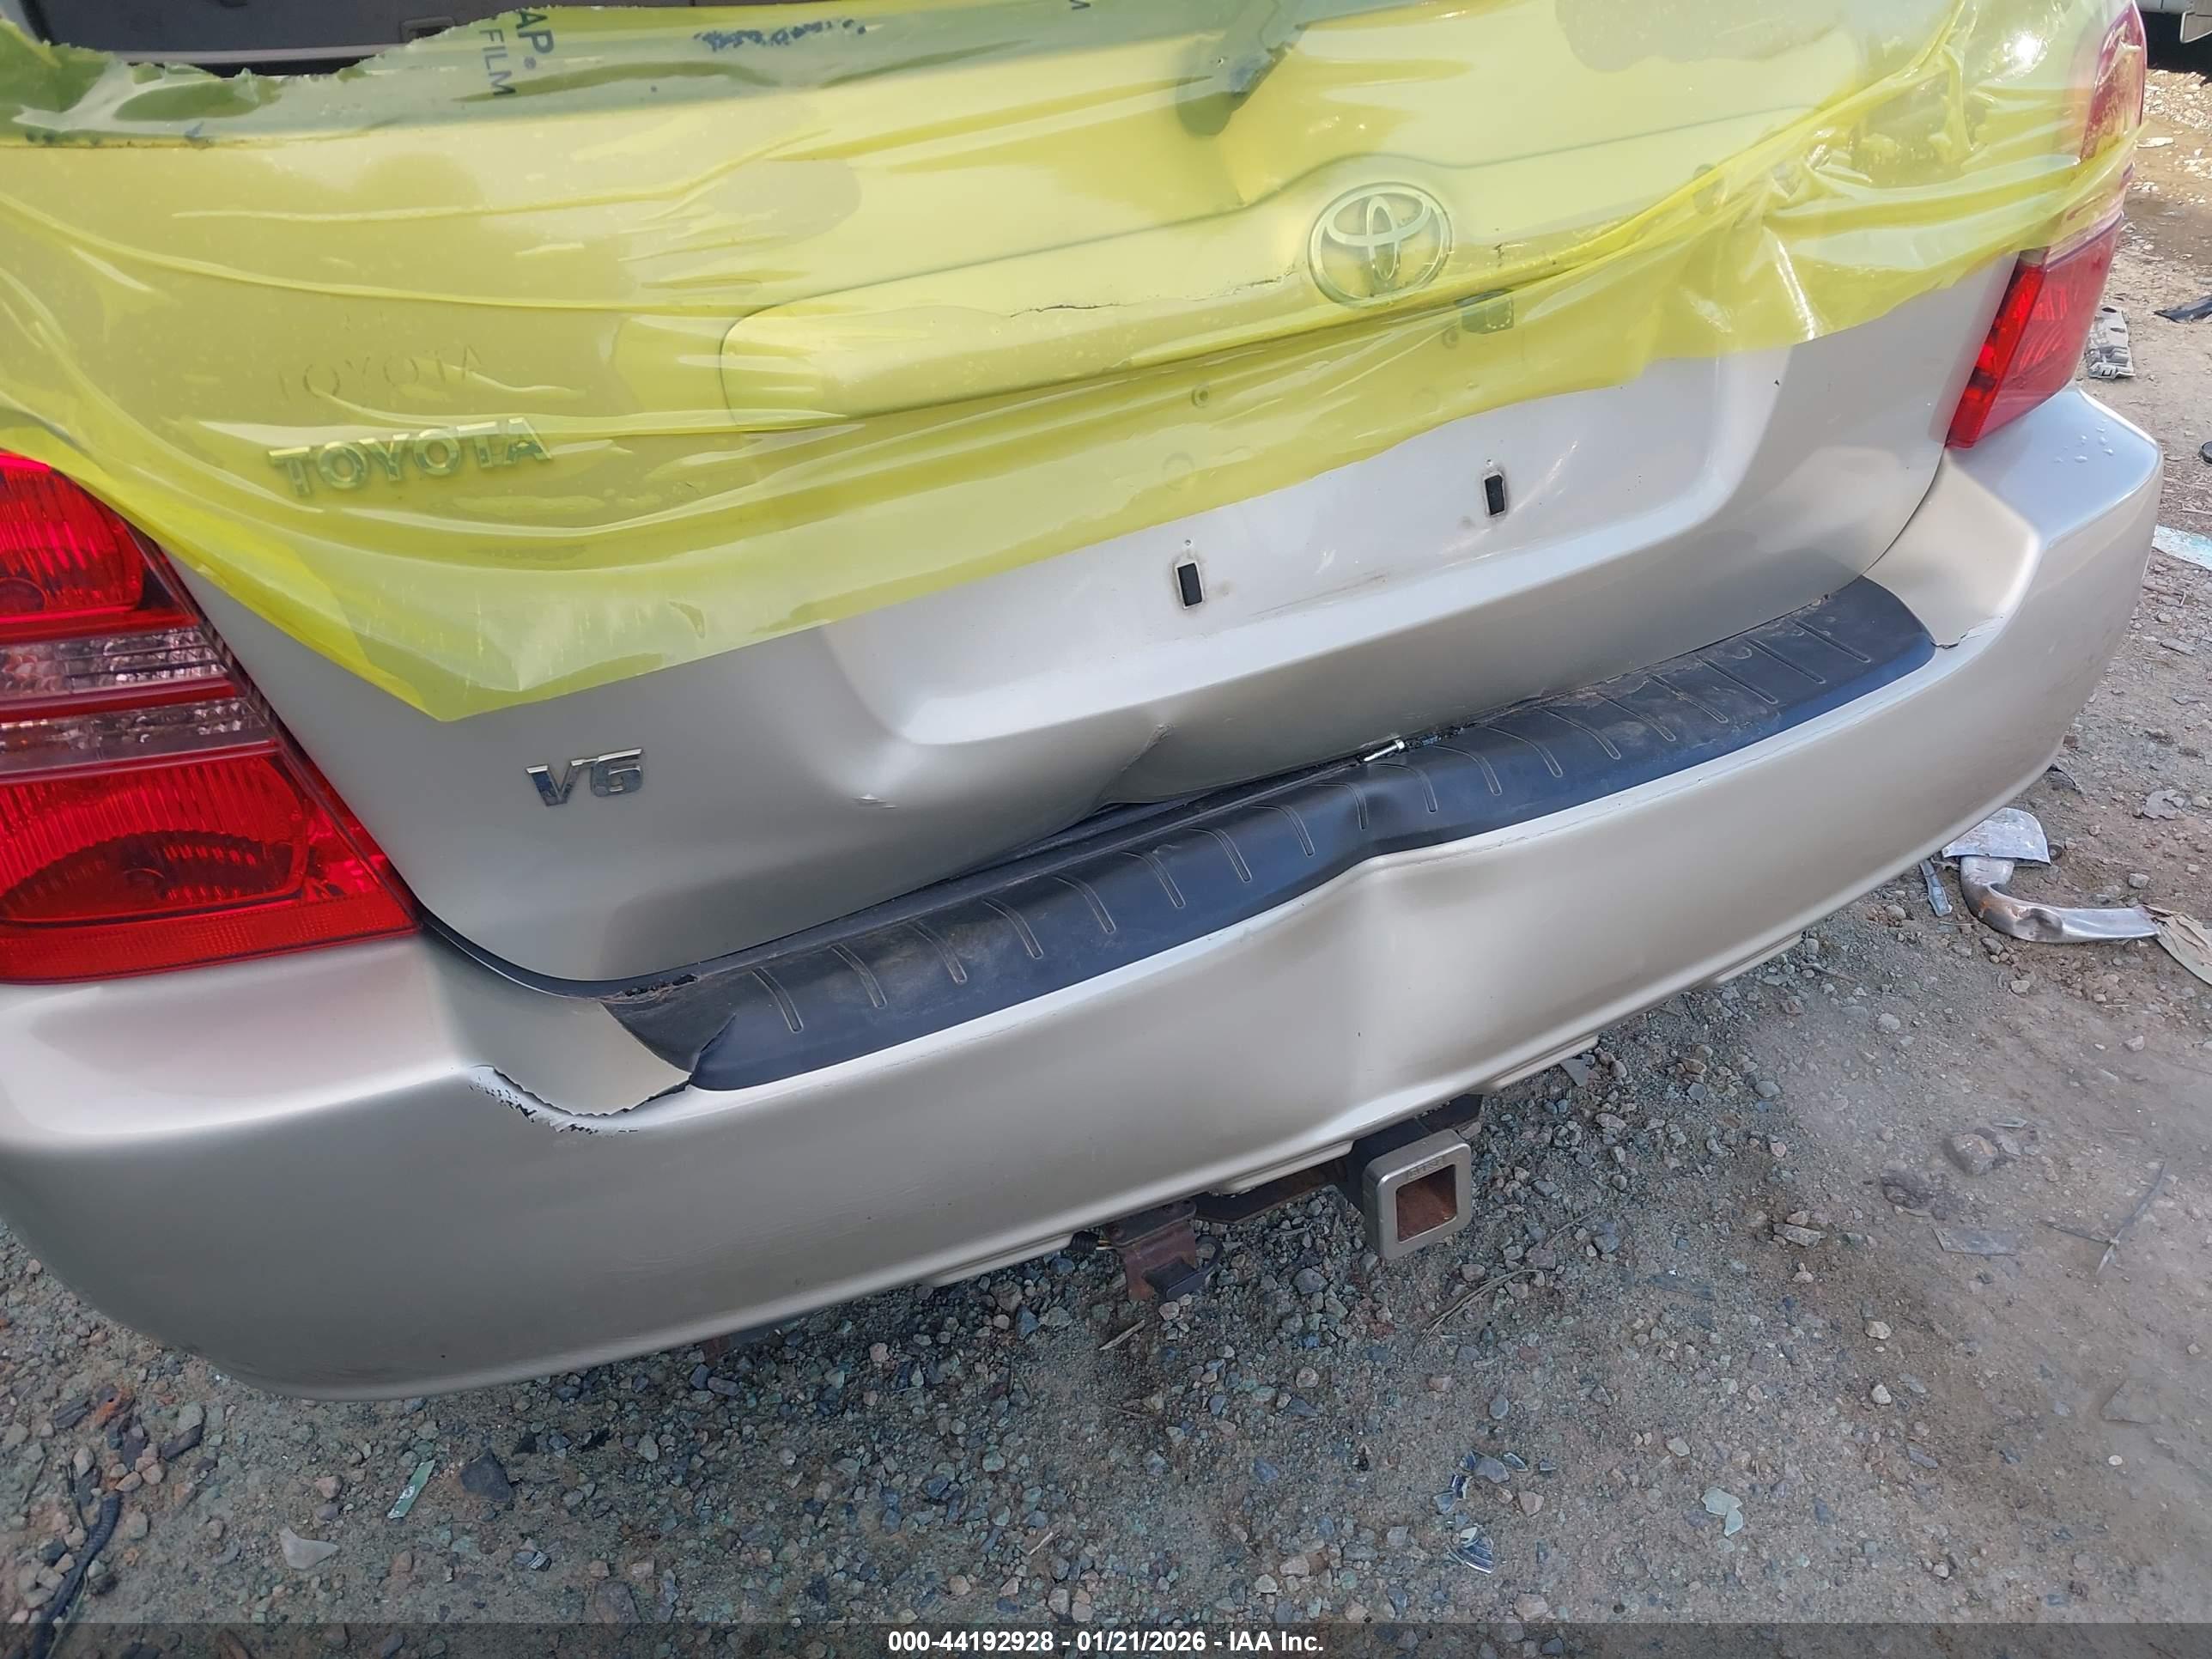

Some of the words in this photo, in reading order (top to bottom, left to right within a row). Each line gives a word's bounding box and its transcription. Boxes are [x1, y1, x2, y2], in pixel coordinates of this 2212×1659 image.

[478, 28, 517, 96] FILM
[268, 416, 553, 496] TOYOTA
[526, 748, 643, 807] V6
